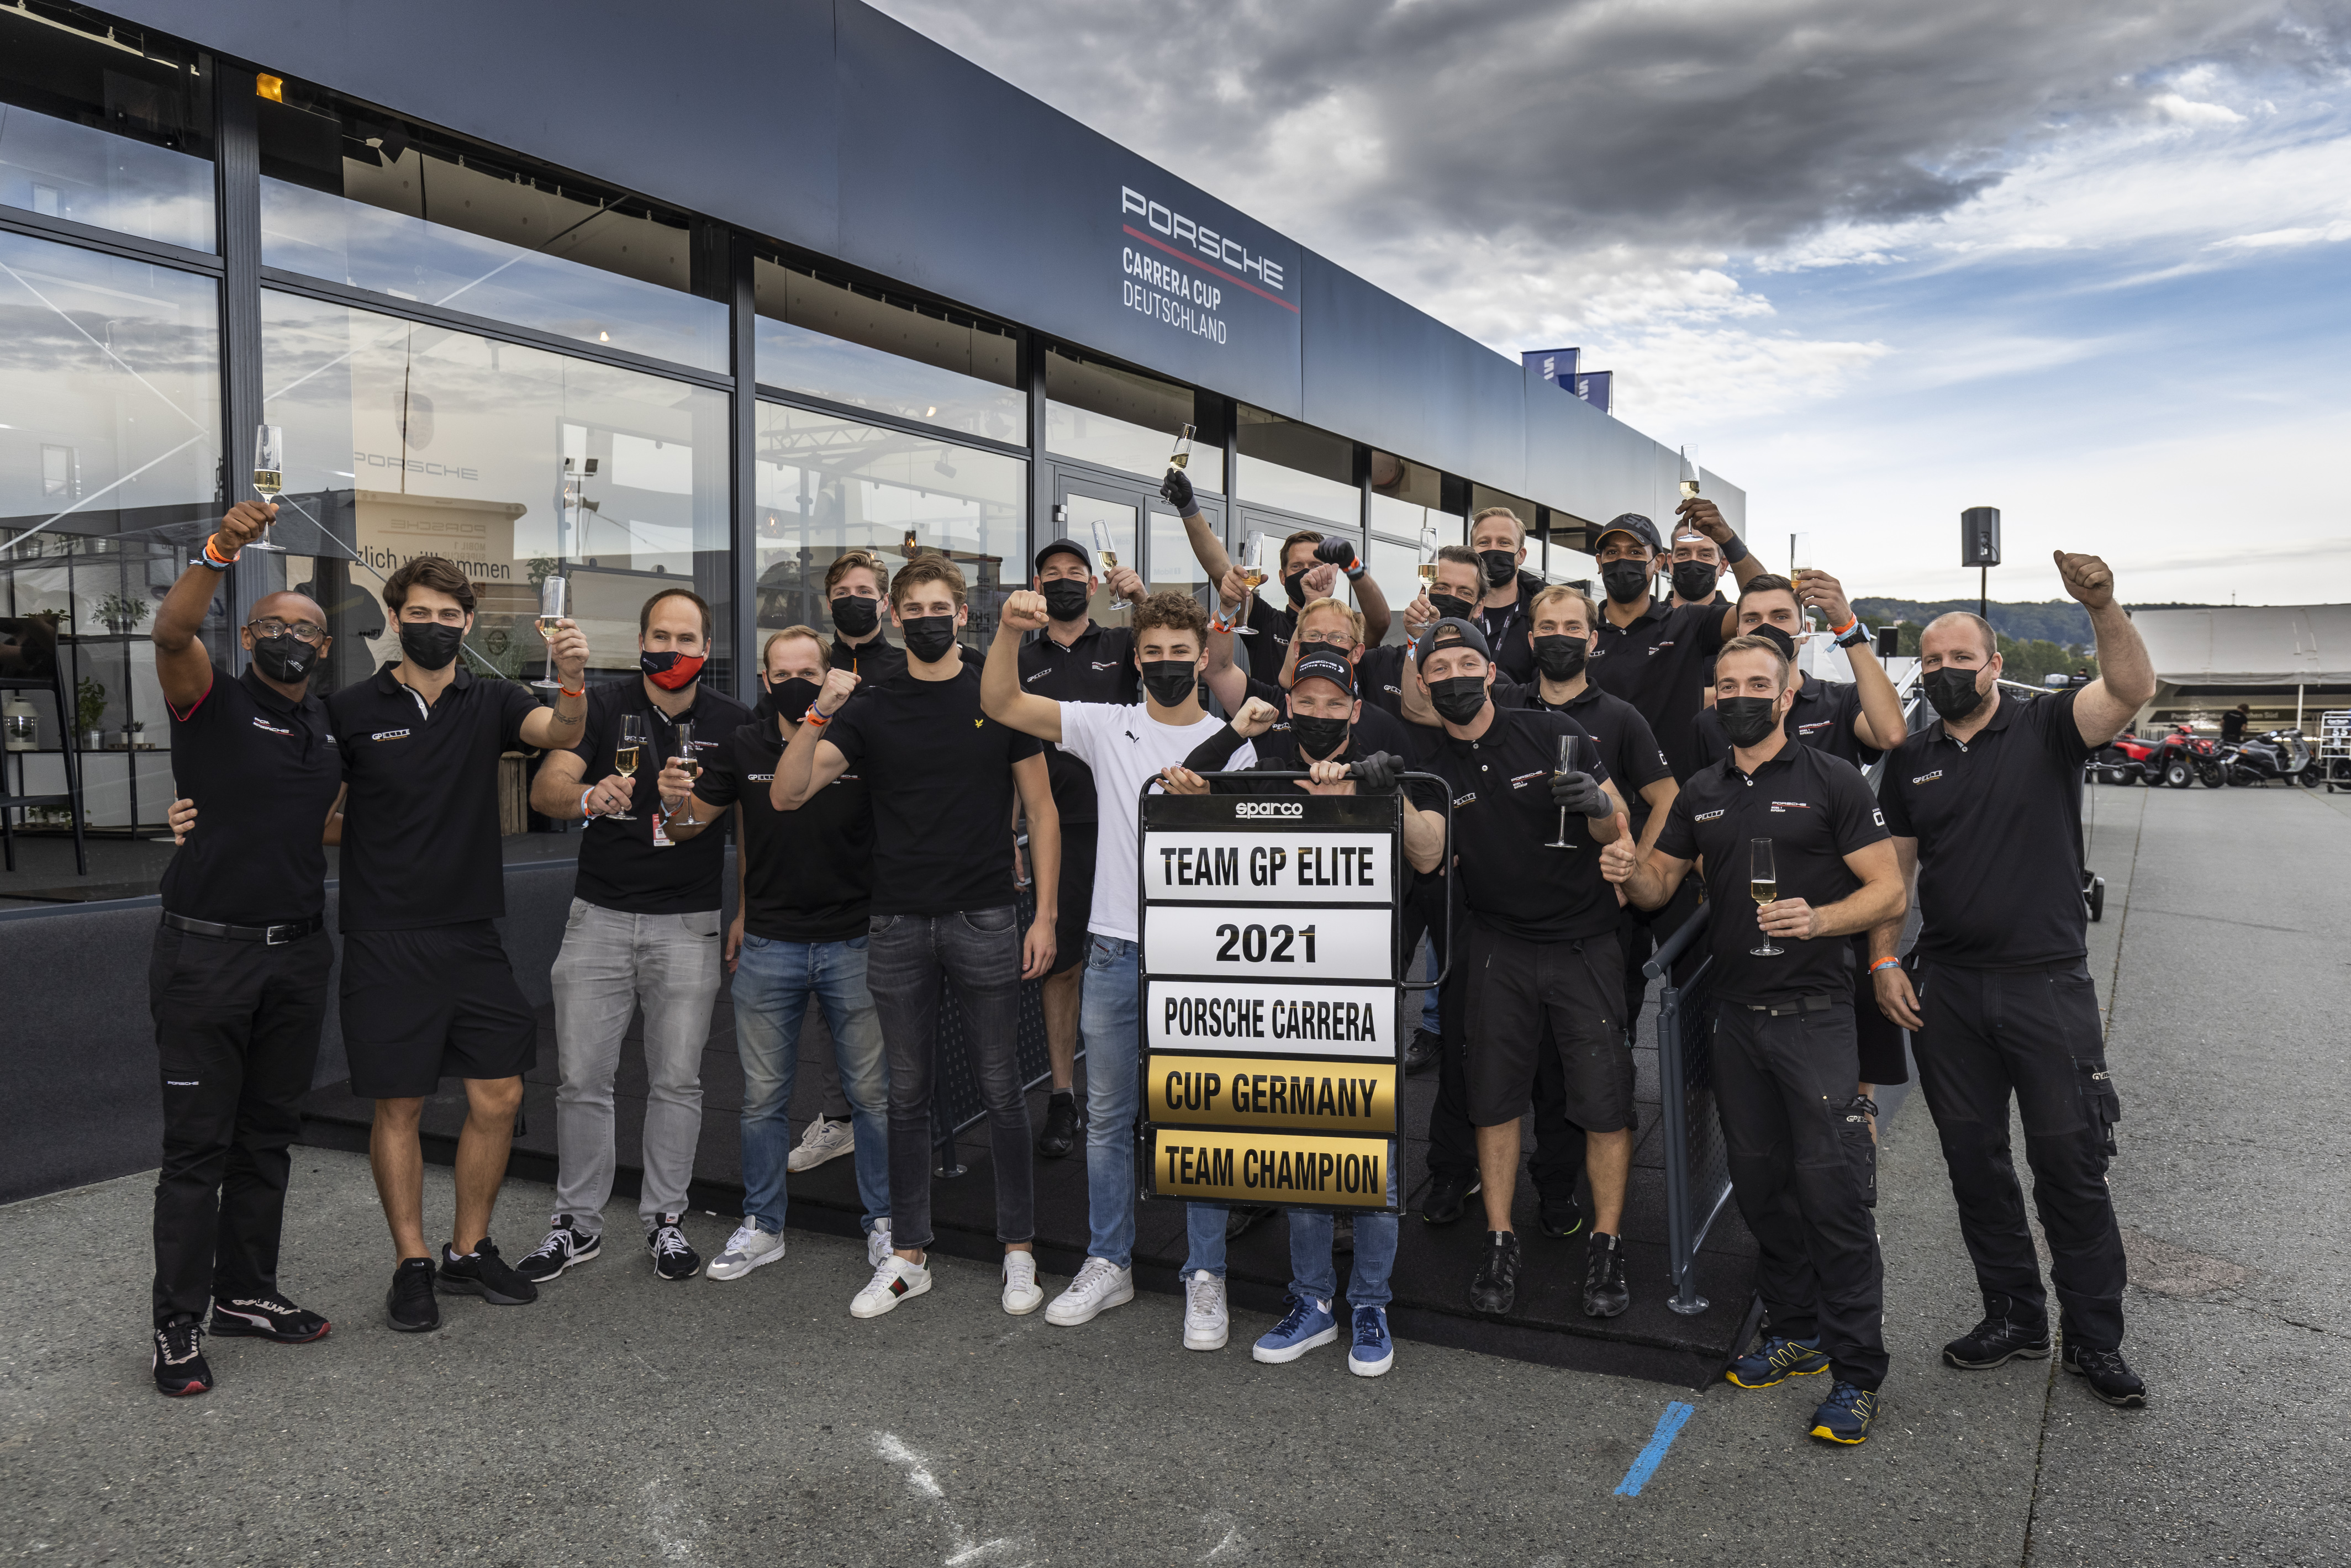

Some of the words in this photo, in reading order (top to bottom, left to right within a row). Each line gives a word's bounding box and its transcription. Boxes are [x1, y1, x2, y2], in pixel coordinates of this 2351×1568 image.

[1122, 185, 1283, 290] PORSCHE
[1123, 247, 1190, 300] CARRERA
[1193, 279, 1221, 310] CUP
[1124, 279, 1226, 345] DEUTSCHLAND
[1799, 720, 1830, 728] PORSCHE
[1511, 770, 1543, 782] PORSCHE
[1236, 802, 1303, 819] sparco
[1160, 847, 1238, 886] TEAM
[1250, 846, 1286, 886] GP
[1298, 847, 1374, 886] ELITE
[1216, 923, 1316, 963] 2021
[1165, 997, 1264, 1038] PORSCHE
[1272, 999, 1376, 1042] CARRERA
[1165, 1070, 1221, 1111] CUP
[1232, 1073, 1378, 1118] GERMANY
[1165, 1145, 1234, 1187] TEAM
[1243, 1149, 1379, 1195] CHAMPION
